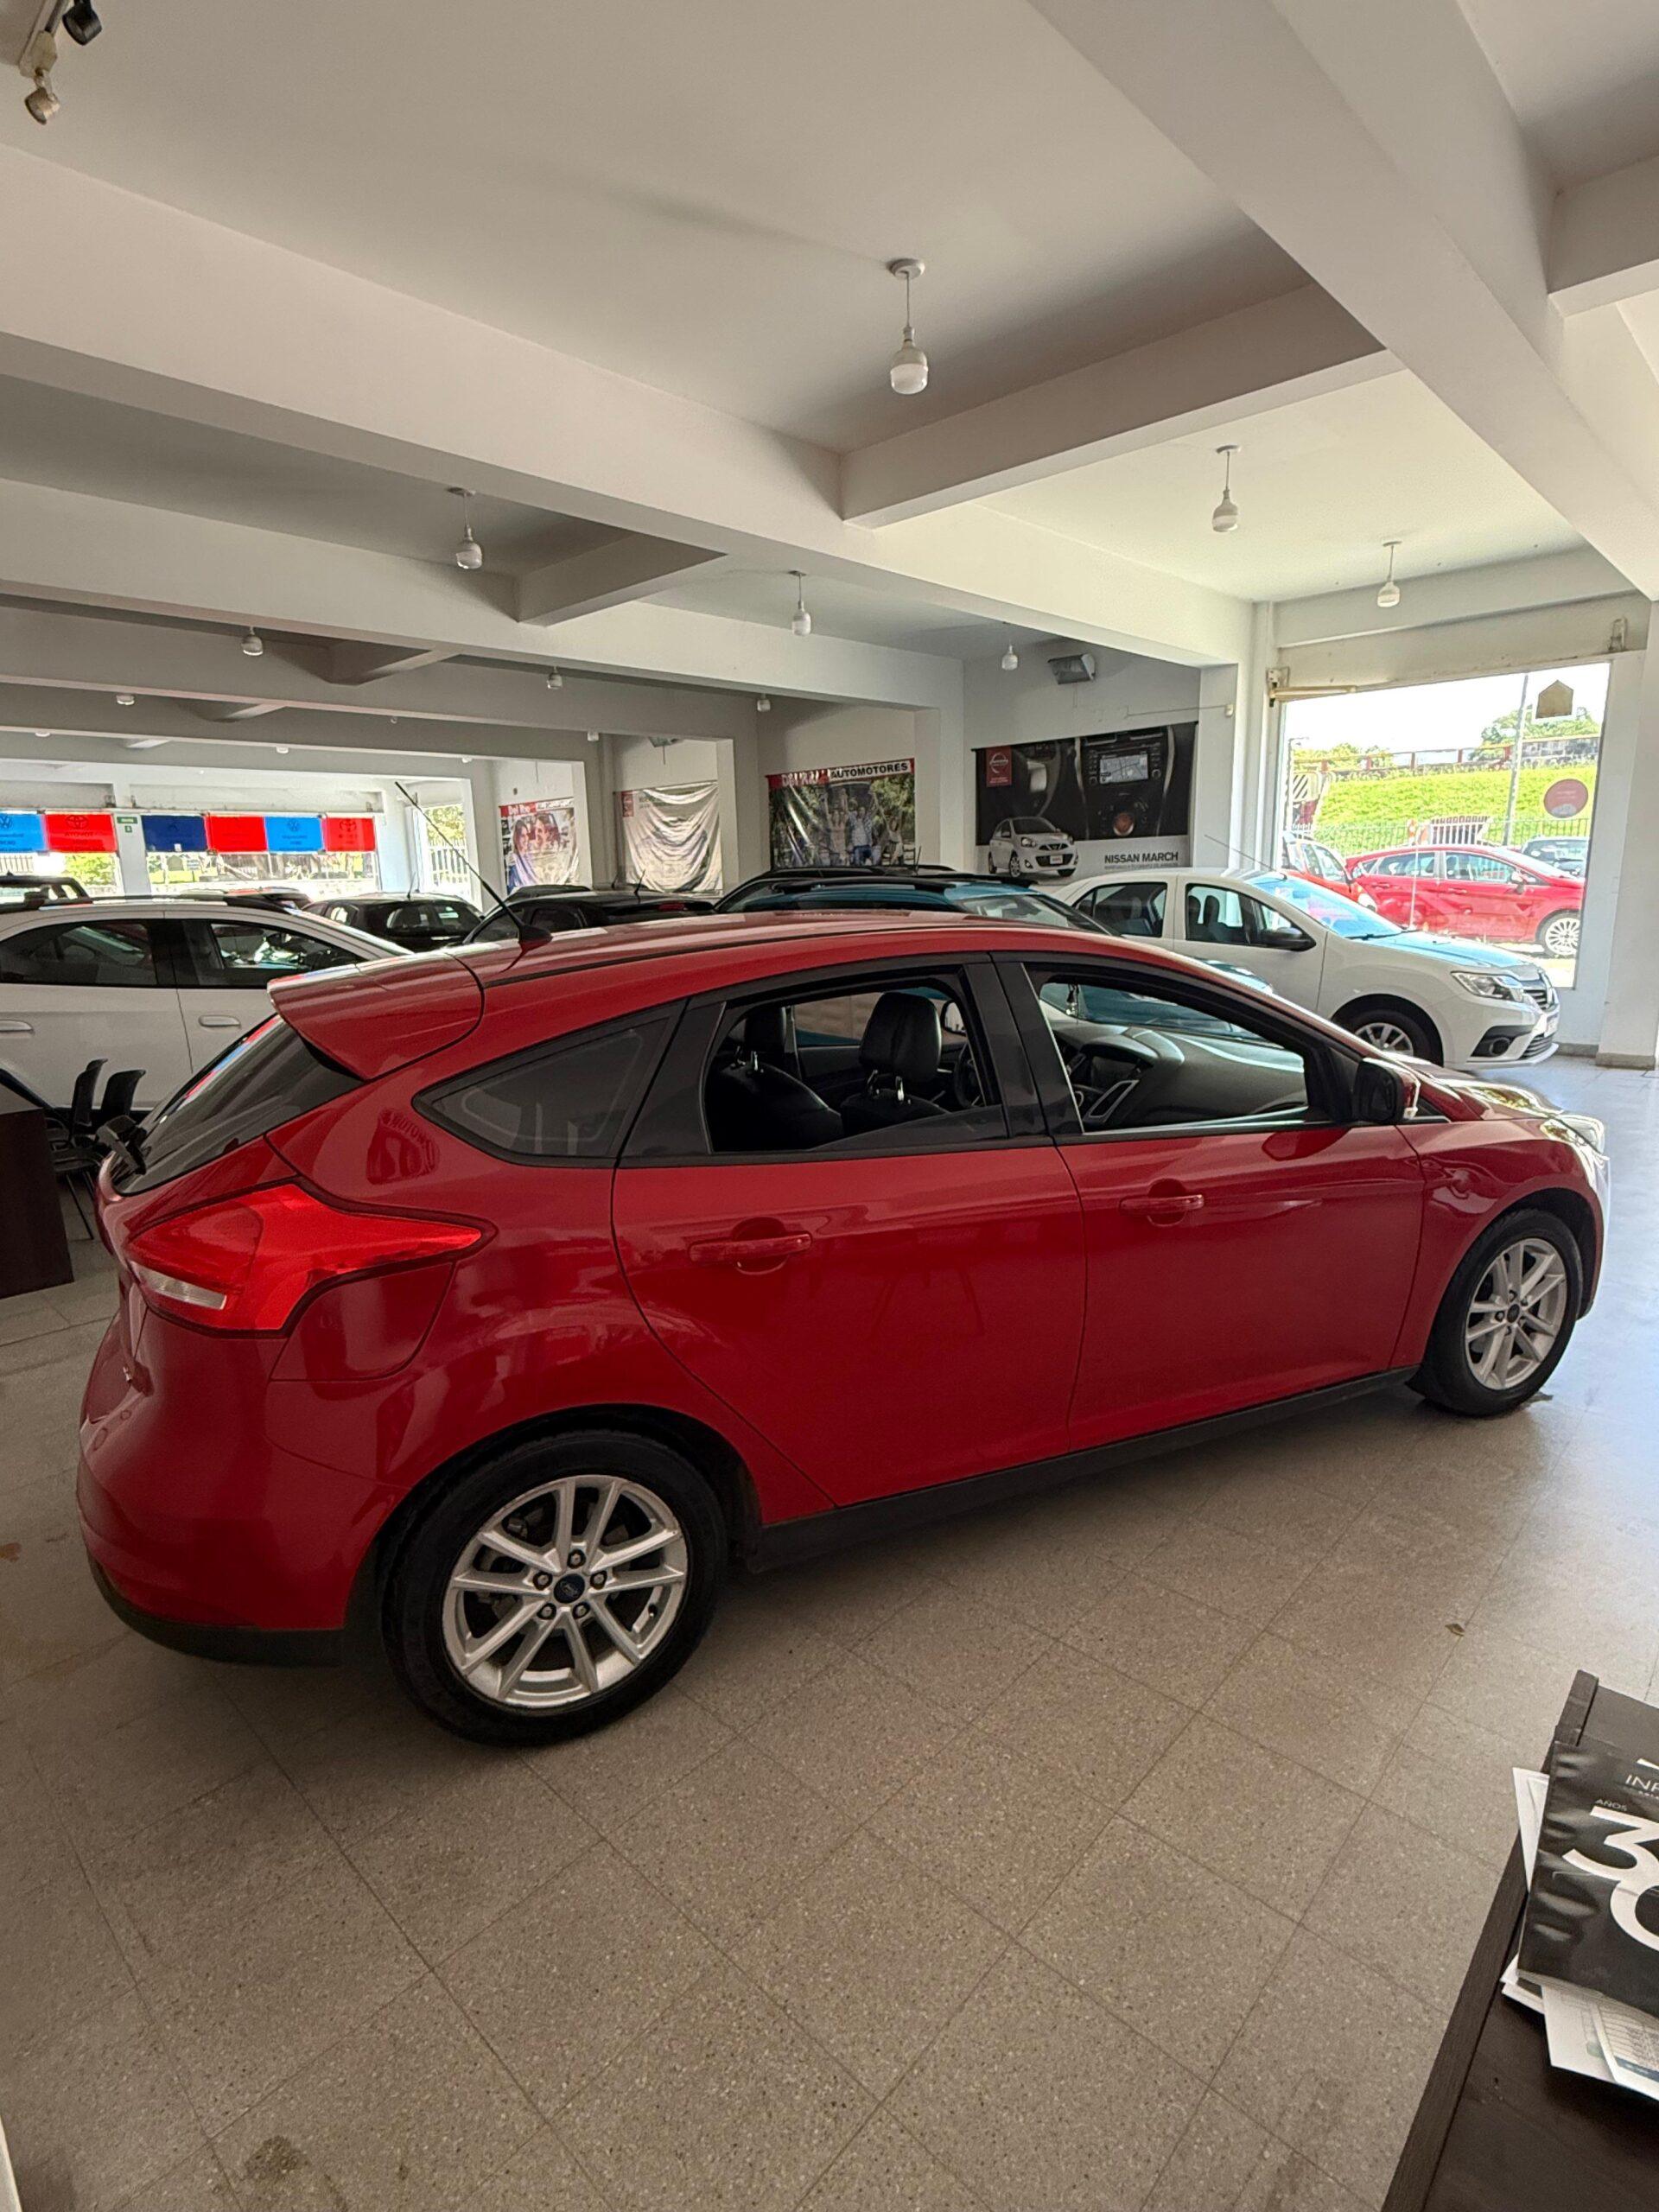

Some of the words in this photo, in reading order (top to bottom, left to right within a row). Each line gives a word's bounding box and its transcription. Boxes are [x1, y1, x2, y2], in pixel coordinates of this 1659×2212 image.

[830, 762, 908, 779] AUTOMOTORES
[1104, 853, 1141, 863] NISSAN
[1141, 852, 1179, 862] MARCH
